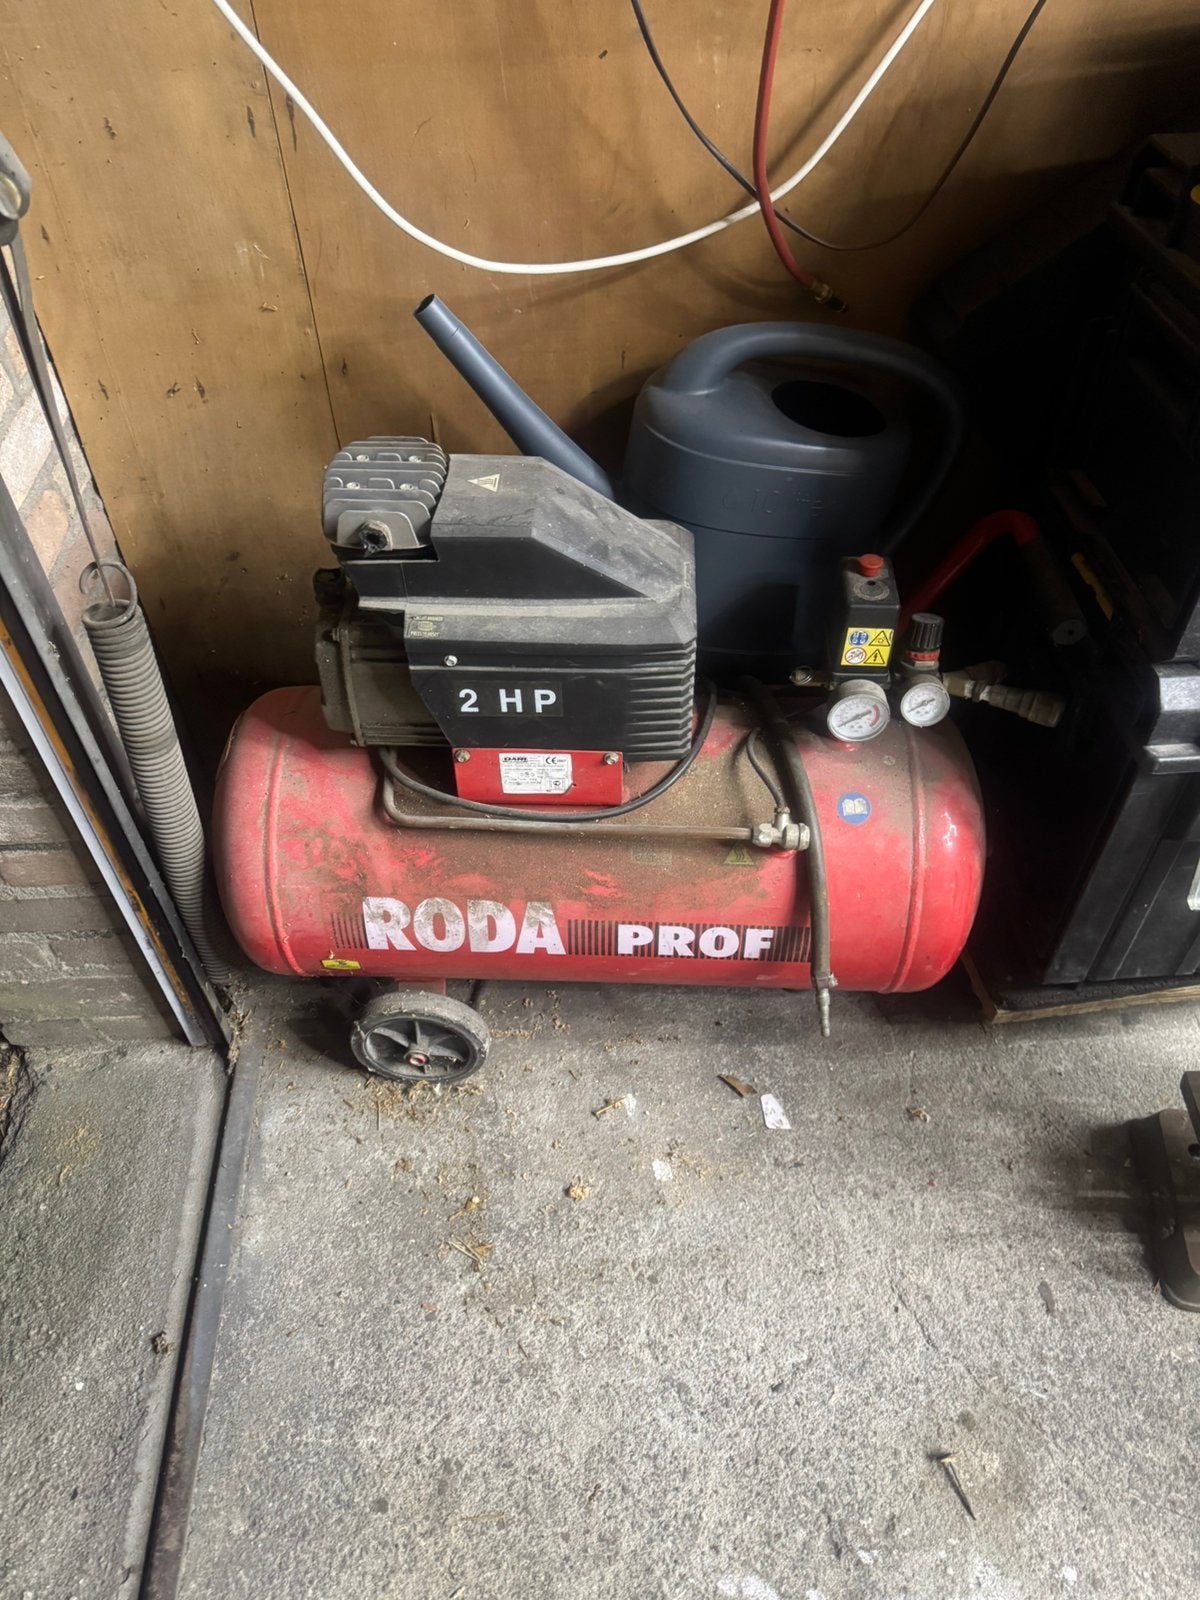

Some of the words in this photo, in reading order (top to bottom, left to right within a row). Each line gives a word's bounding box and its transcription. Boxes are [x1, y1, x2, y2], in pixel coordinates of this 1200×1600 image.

[458, 688, 480, 713] 2
[499, 688, 558, 714] HP
[362, 896, 567, 955] RODA
[617, 924, 774, 959] PROF
